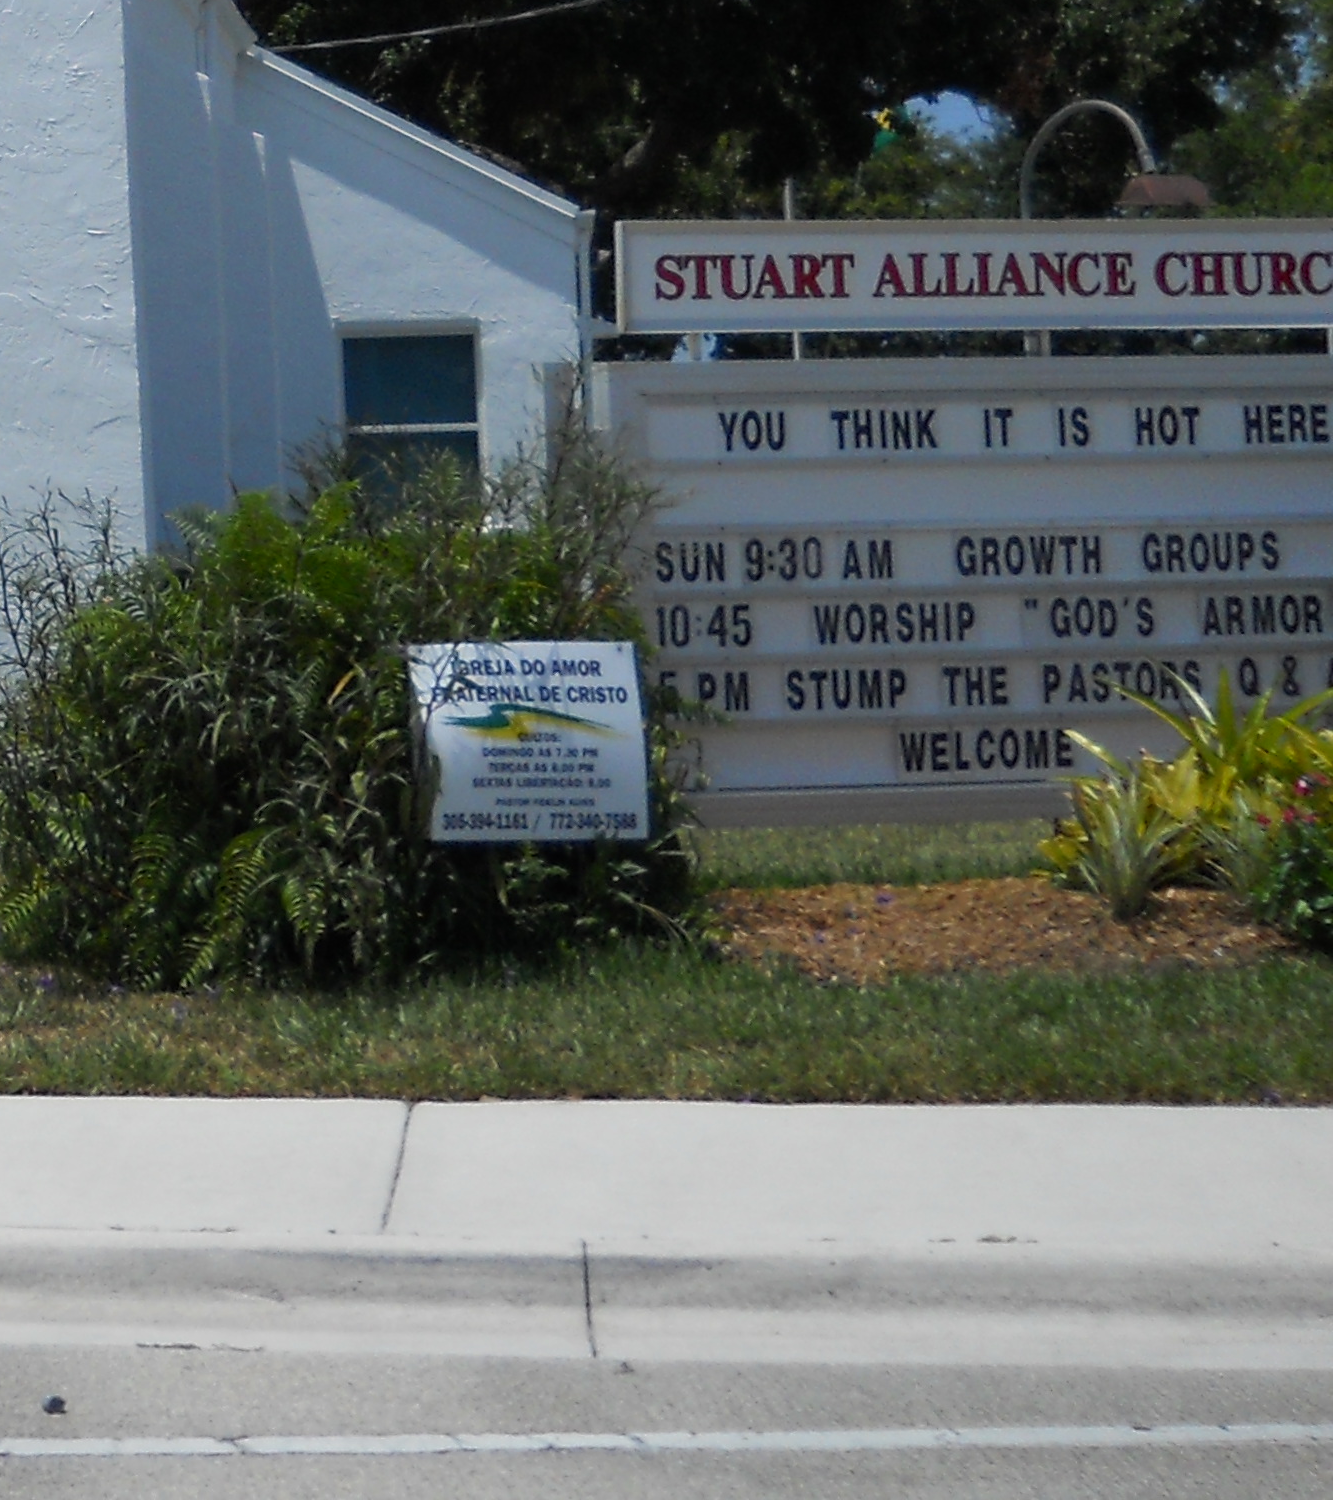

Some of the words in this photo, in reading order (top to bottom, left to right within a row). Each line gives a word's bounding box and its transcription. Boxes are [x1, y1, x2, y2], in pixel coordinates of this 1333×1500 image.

[655, 253, 854, 300] STUART
[872, 251, 1136, 298] ALLIANCE
[718, 410, 786, 451] YOU
[831, 408, 938, 450] THINK
[984, 407, 1013, 447] IT
[1058, 406, 1090, 447] IS
[1135, 405, 1200, 445] HOT
[1244, 404, 1330, 444] HERE
[655, 542, 726, 583] SUN
[745, 537, 824, 582] 9:30
[843, 540, 893, 579] AM
[956, 534, 1101, 577] GROWTH
[1142, 531, 1280, 573] GROUPS
[656, 604, 752, 648] 10:45
[814, 601, 976, 646] WORSHIP
[1203, 595, 1323, 636] ARMOR
[521, 659, 545, 677] DO
[552, 659, 602, 678] AMOR
[697, 671, 751, 712] PM
[786, 668, 907, 711] STUMP
[942, 665, 1009, 706] THE
[1043, 659, 1202, 704] PASTORS
[1239, 656, 1261, 697] Q
[1283, 655, 1300, 696] &
[539, 685, 561, 702] DE
[567, 686, 629, 704] CRISTO
[899, 727, 1075, 772] WELCOME
